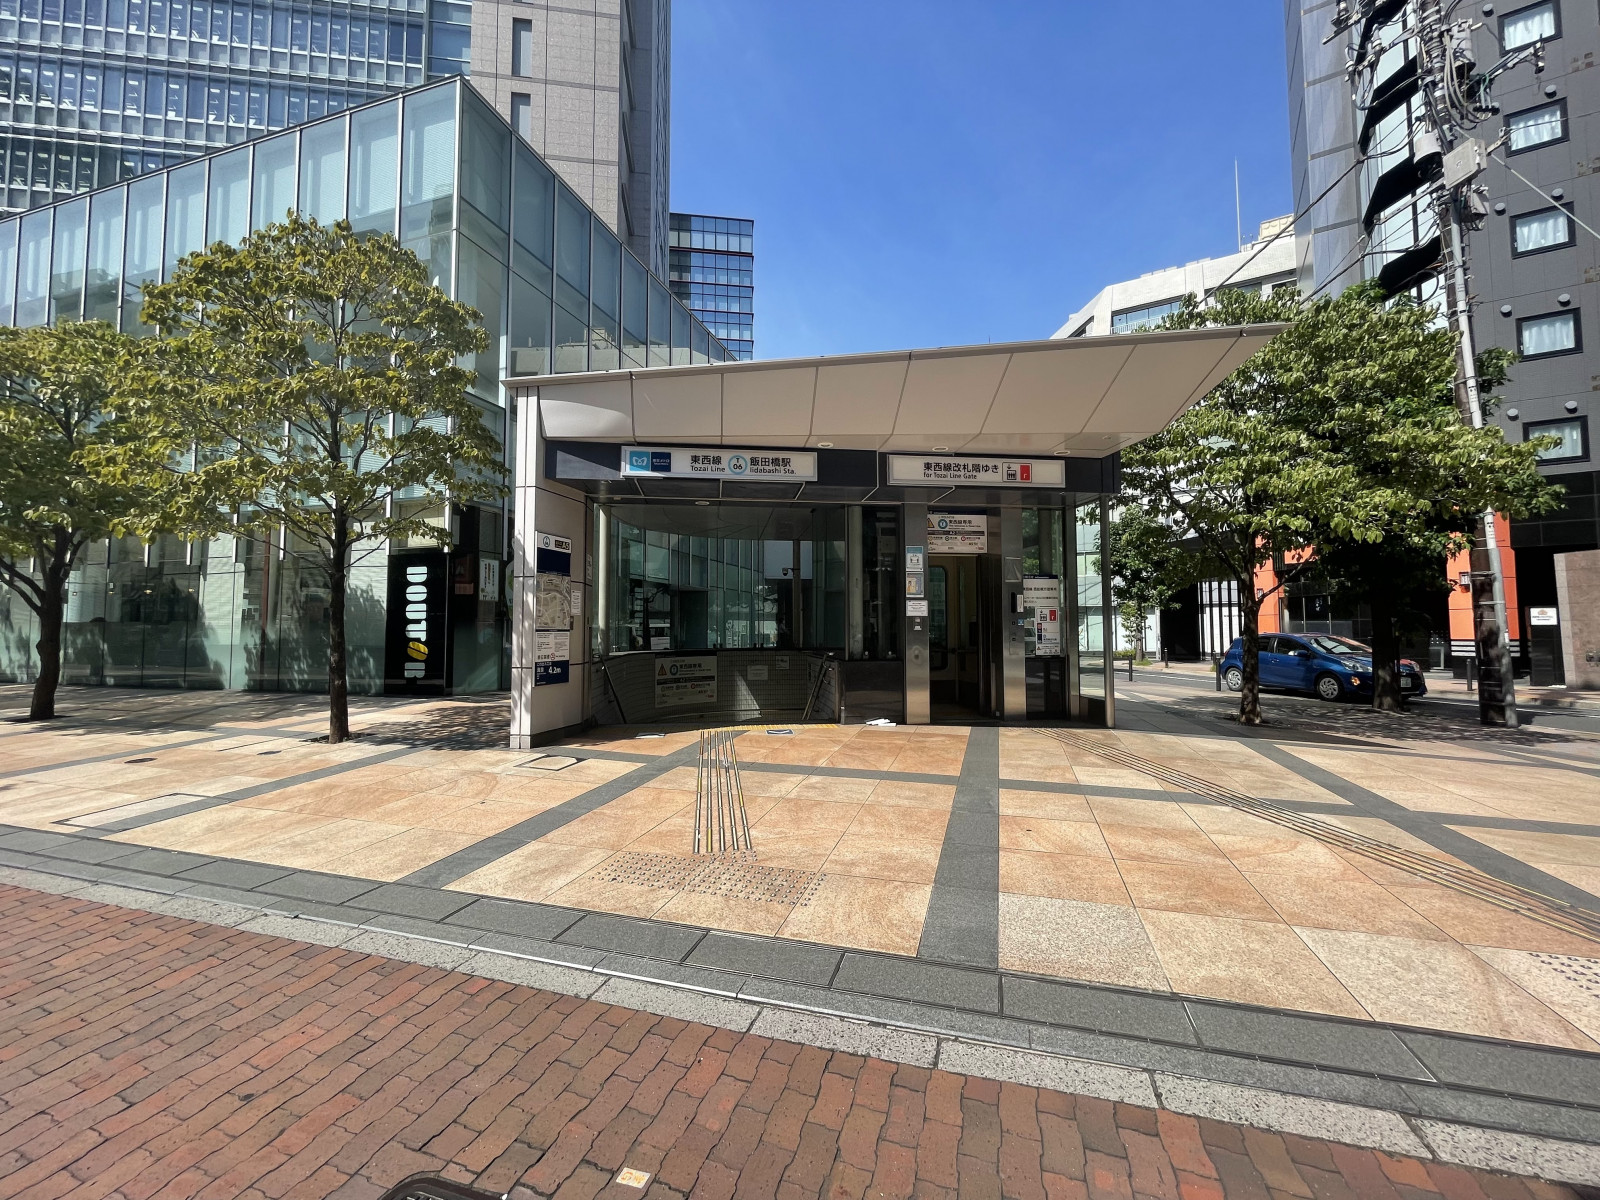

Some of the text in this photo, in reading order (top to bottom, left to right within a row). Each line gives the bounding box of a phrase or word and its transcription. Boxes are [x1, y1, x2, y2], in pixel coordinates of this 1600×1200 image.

[690, 455, 722, 466] 東西線
[750, 456, 792, 468] 飯田橋駅
[924, 462, 998, 473] 東西線改札階ゆき
[404, 566, 429, 679] DOUTOR
